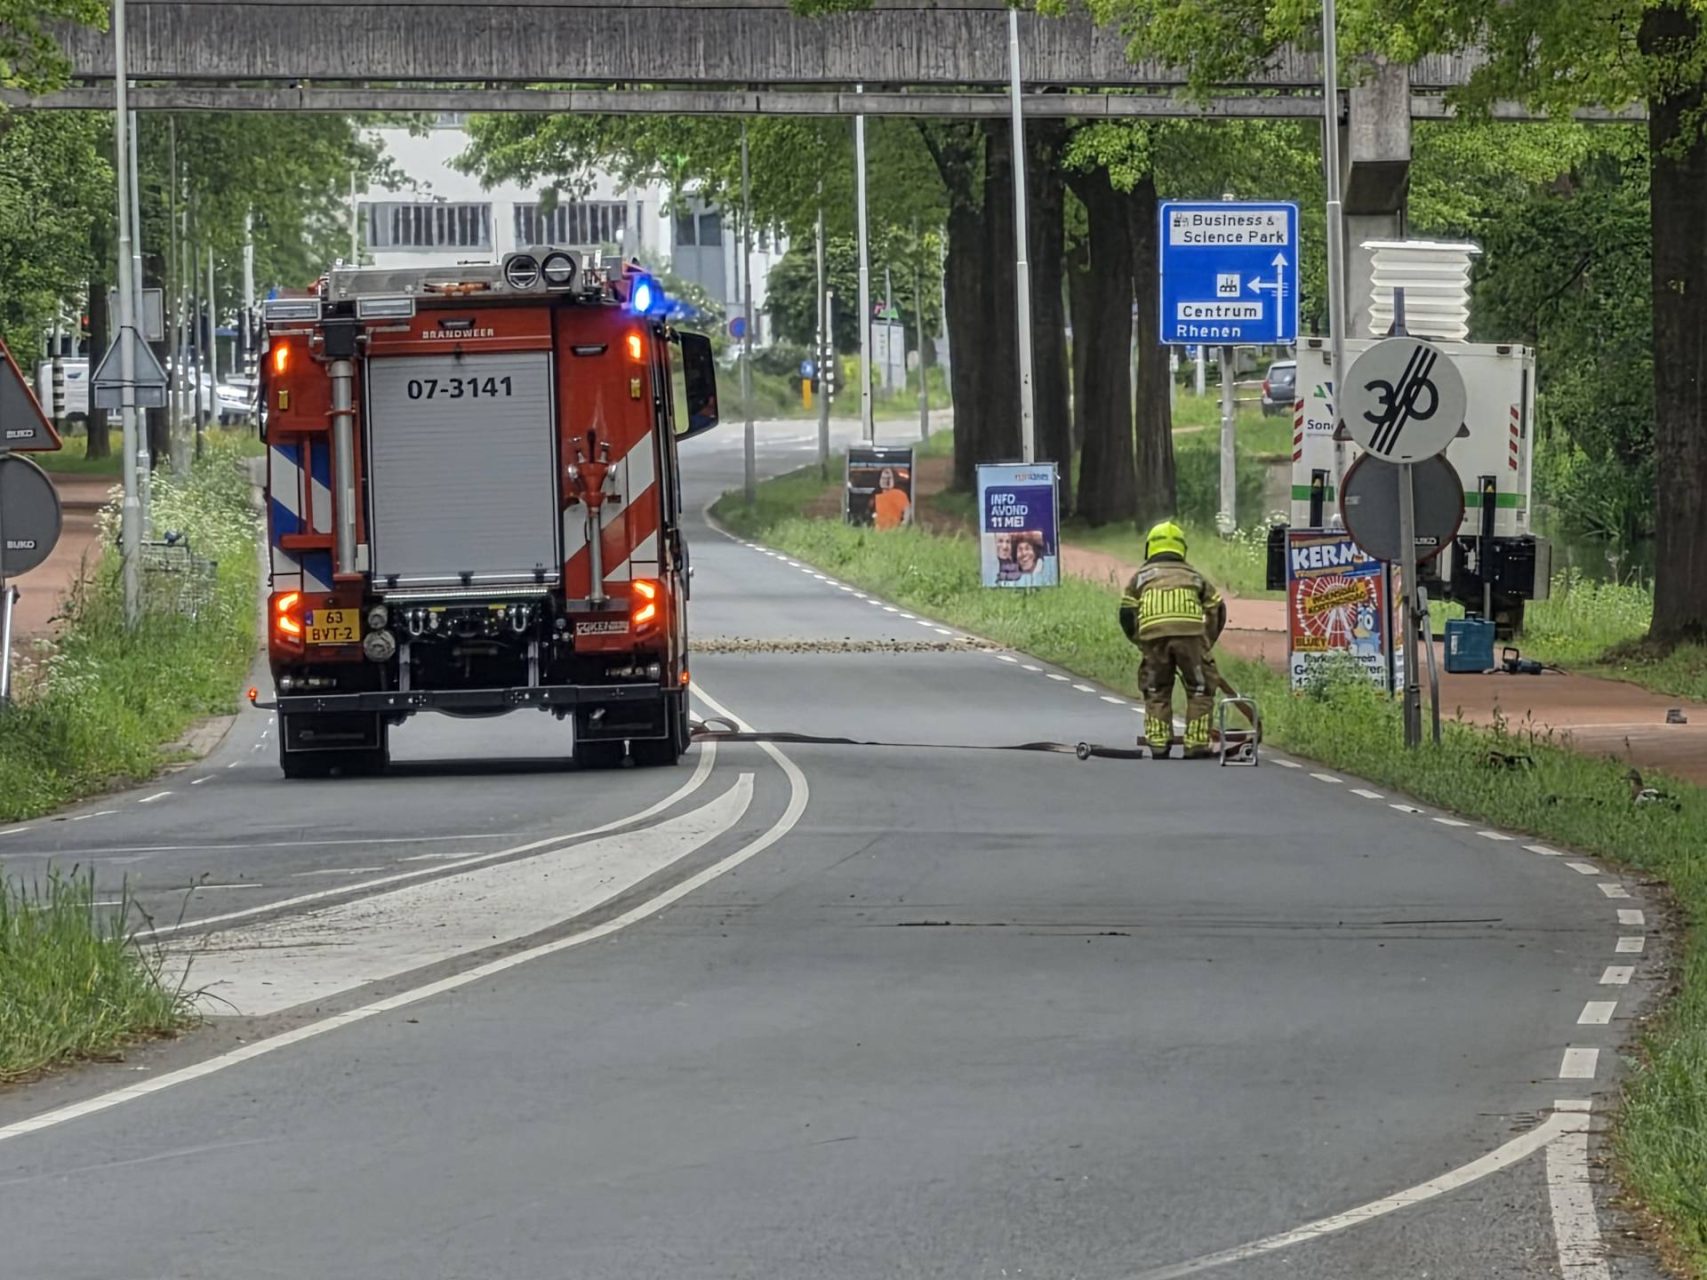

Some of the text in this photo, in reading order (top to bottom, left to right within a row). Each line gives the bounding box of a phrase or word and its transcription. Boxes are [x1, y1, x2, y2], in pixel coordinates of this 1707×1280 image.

[1192, 214, 1275, 226] Business &
[1183, 230, 1284, 243] Science Park
[1182, 305, 1257, 318] Centrum
[422, 328, 494, 339] BRANDWEER
[1176, 324, 1241, 338] Rhenen
[407, 376, 512, 400] 07-3141
[1363, 377, 1439, 425] 30
[1307, 419, 1335, 431] Son
[991, 493, 1016, 505] INFO
[991, 504, 1029, 516] AVOND
[991, 516, 1025, 528] 11 MEI
[1291, 541, 1377, 571] KERM
[326, 611, 343, 624] 63
[312, 626, 352, 641] BVT-2
